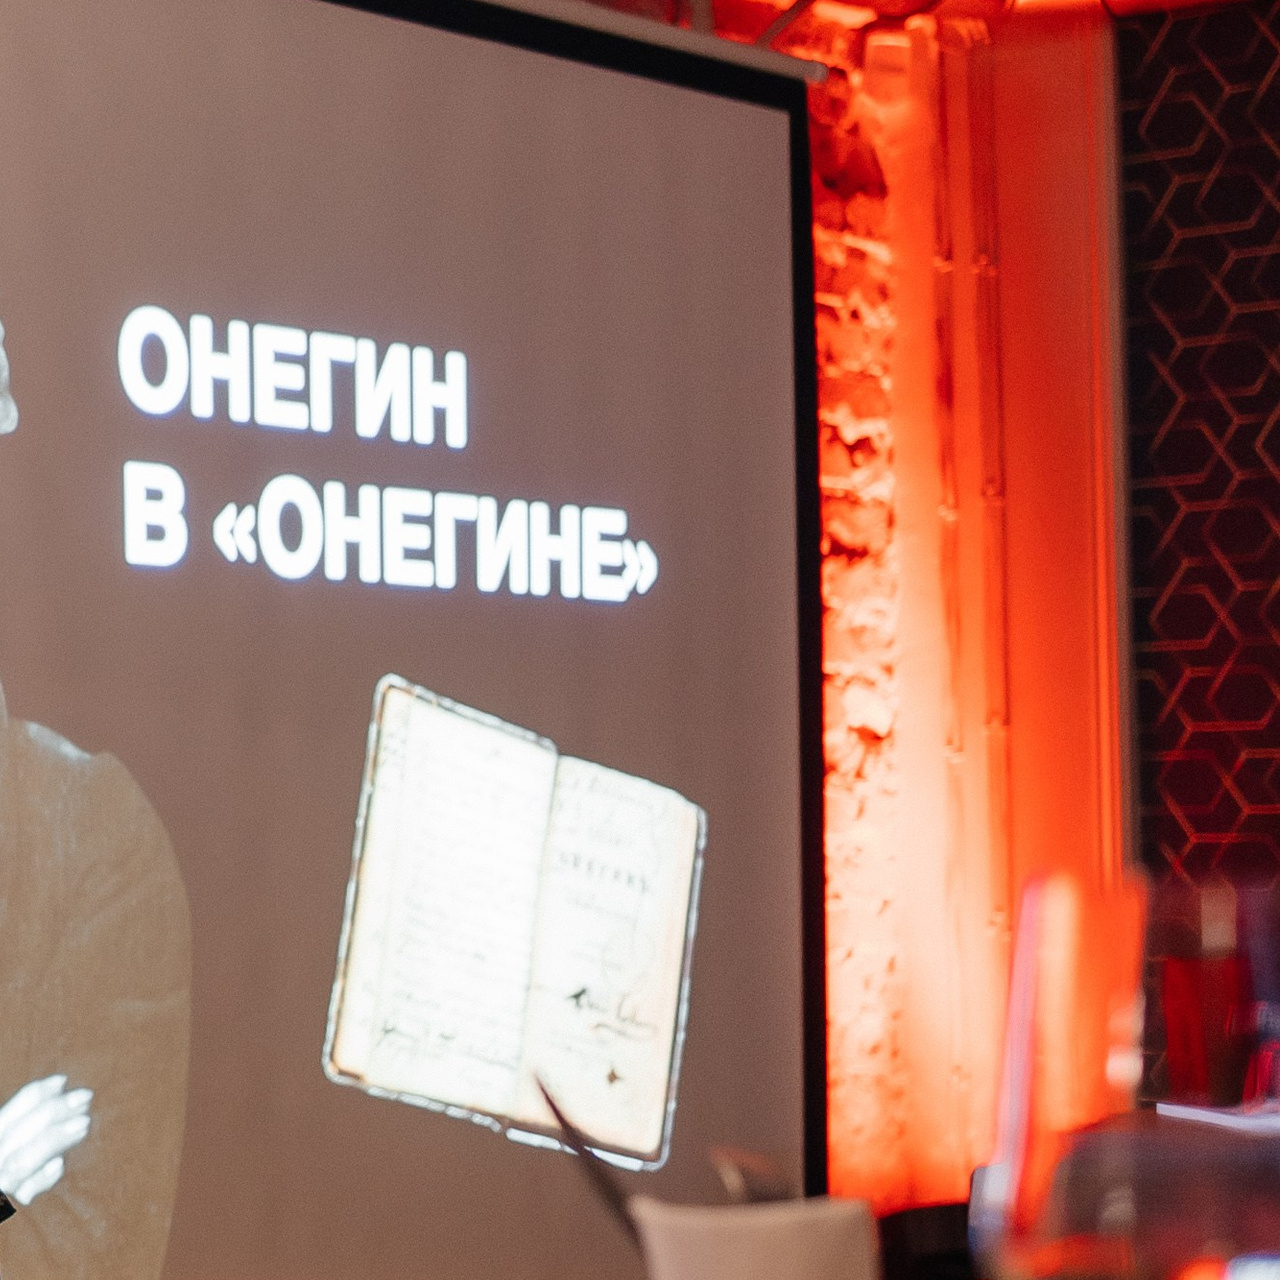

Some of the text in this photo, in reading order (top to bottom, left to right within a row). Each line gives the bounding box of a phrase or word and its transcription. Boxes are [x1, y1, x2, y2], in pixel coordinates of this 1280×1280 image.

[117, 305, 468, 450] ОНЕГИН
[123, 460, 659, 603] В «ОНЕГИНЕ»
